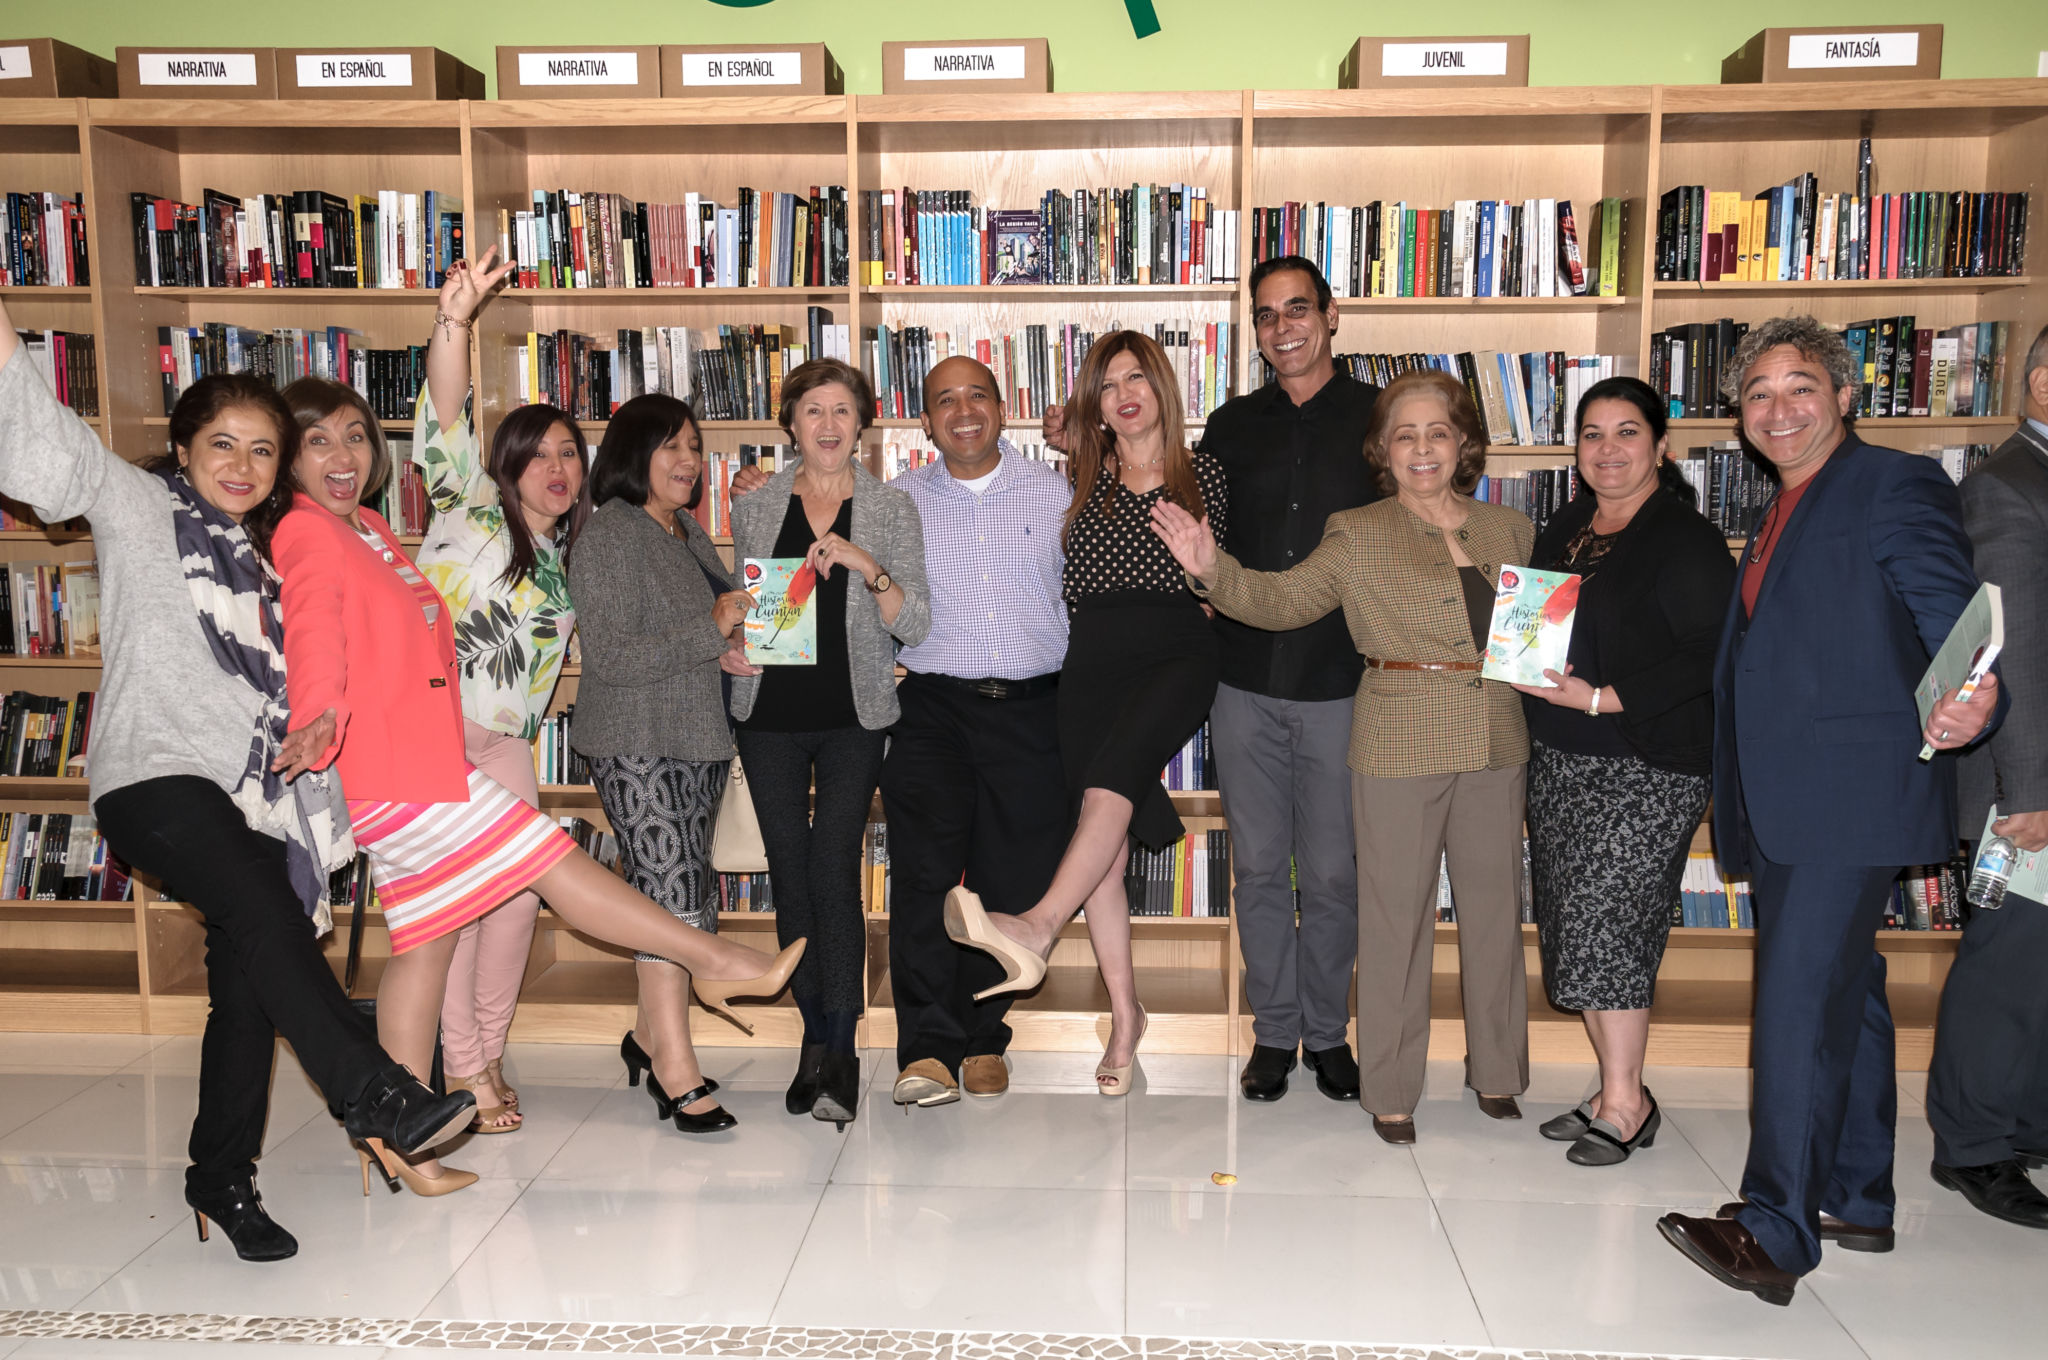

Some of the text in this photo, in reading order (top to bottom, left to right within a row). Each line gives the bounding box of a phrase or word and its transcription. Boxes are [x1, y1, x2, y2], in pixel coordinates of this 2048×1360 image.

[1825, 37, 1881, 59] FANTASÍA
[321, 58, 387, 78] EN ESPAÑOL
[548, 60, 608, 76] NARRATIVA
[708, 57, 775, 77] EN ESPAÑOL
[934, 55, 995, 71] NARRATIVA
[1422, 51, 1466, 68] JUVENIL
[167, 61, 227, 78] NARRATIVA
[1935, 360, 1947, 396] DUNE
[755, 604, 801, 619] Cuentan
[1504, 617, 1546, 632] Cuent
